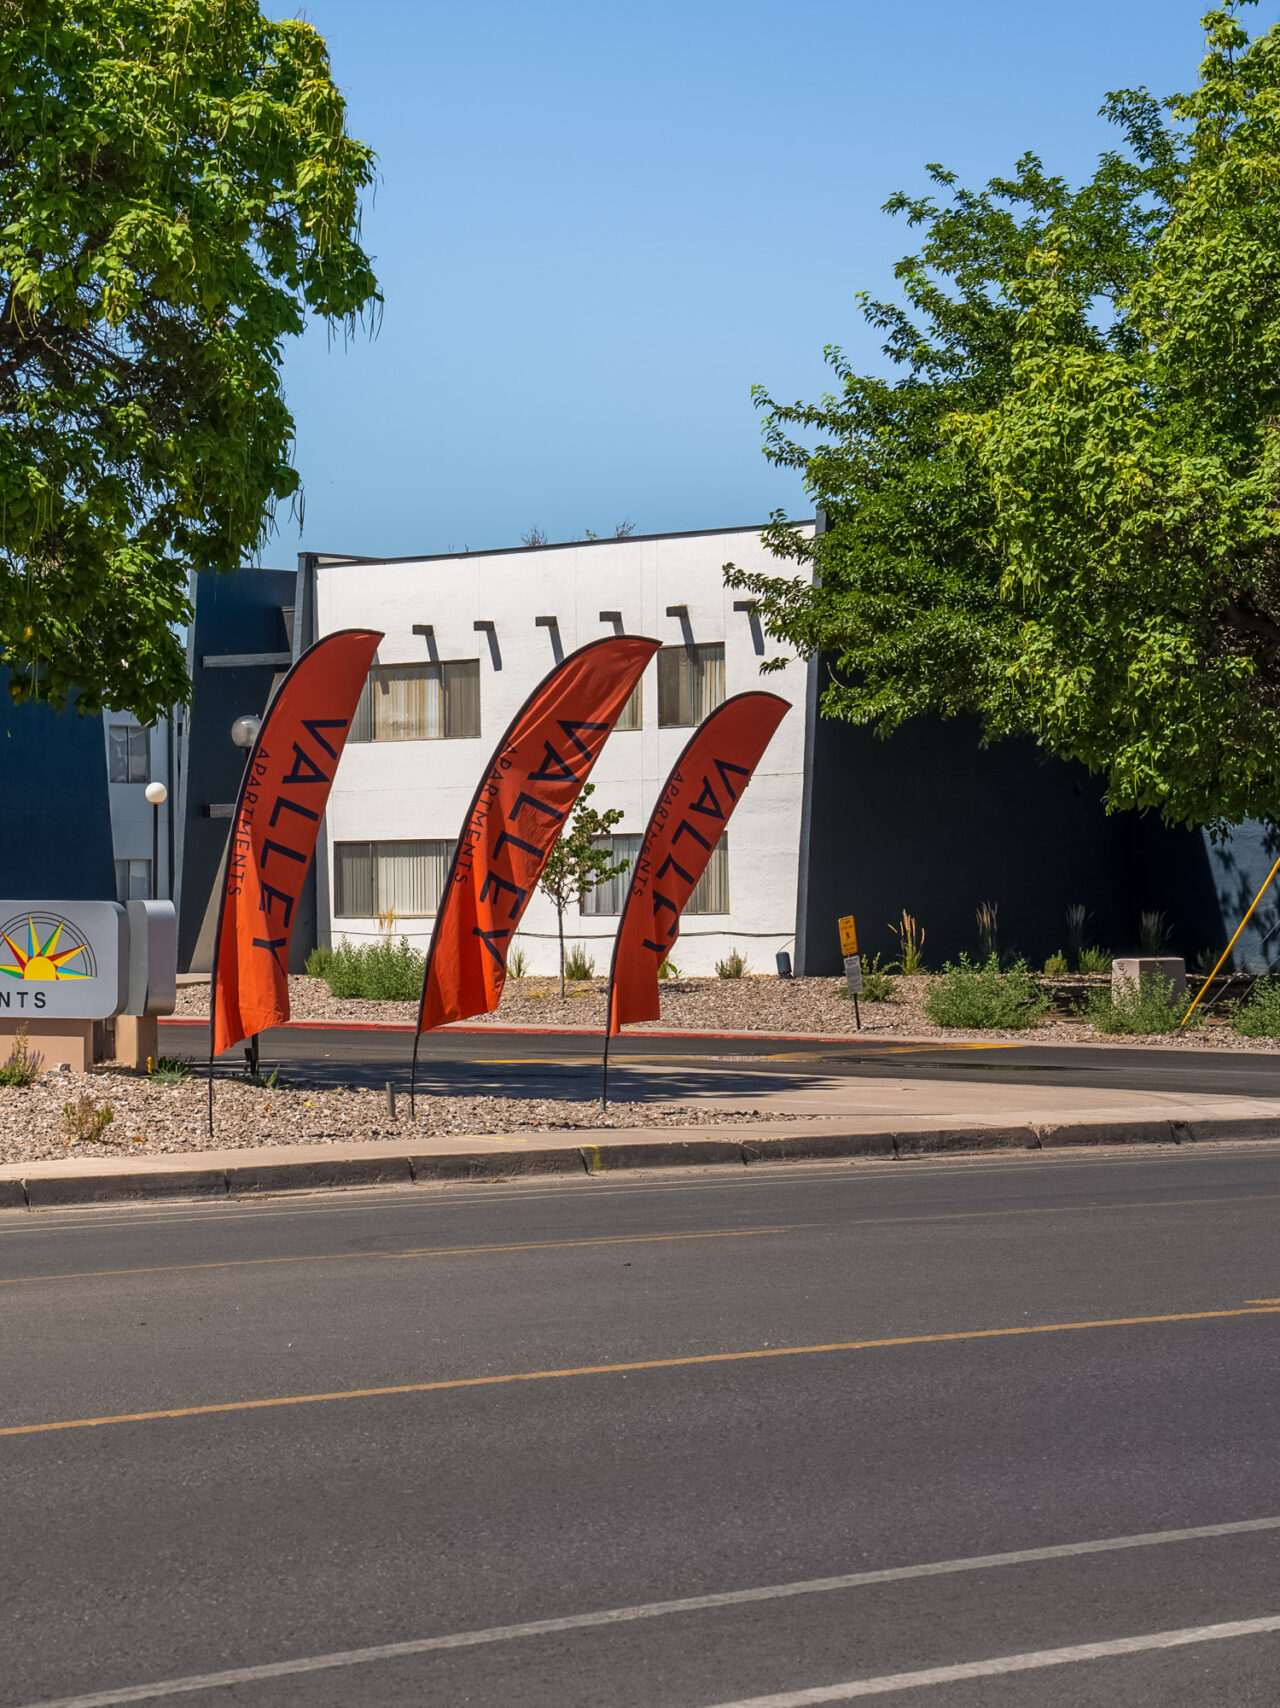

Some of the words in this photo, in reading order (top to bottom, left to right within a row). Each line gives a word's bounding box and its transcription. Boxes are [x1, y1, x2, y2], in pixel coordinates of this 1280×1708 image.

[228, 747, 270, 896] APARTMENTS
[252, 719, 349, 977] VALLEY
[455, 742, 518, 884] APARTMENTS
[472, 720, 610, 969] VALLEY
